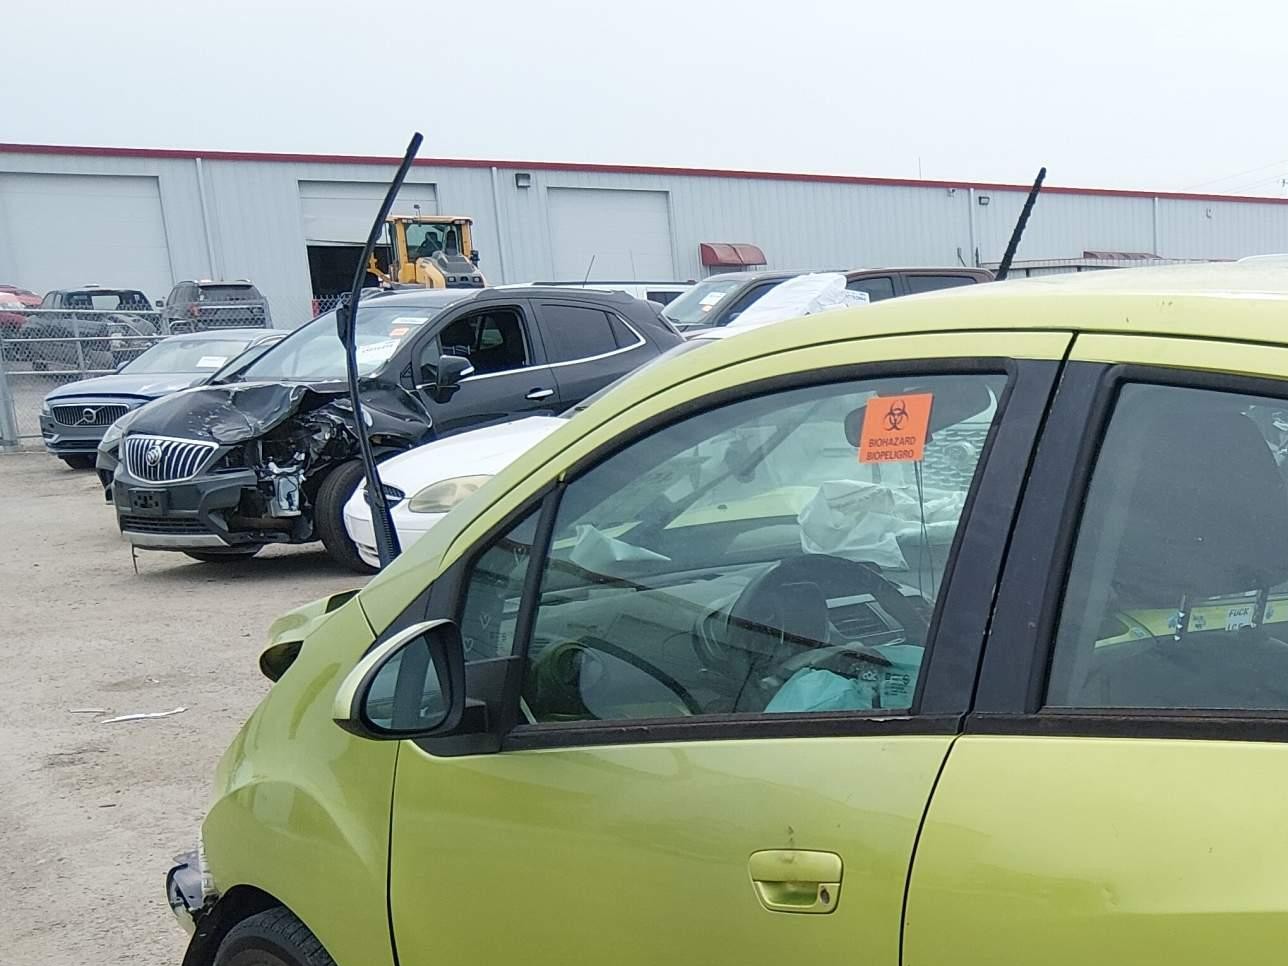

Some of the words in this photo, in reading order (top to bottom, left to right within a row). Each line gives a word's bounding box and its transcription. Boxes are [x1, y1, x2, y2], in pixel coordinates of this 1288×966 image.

[868, 436, 916, 448] BIOHAZARD
[866, 449, 914, 461] BIOPELIGRO
[1229, 607, 1250, 617] FUCK
